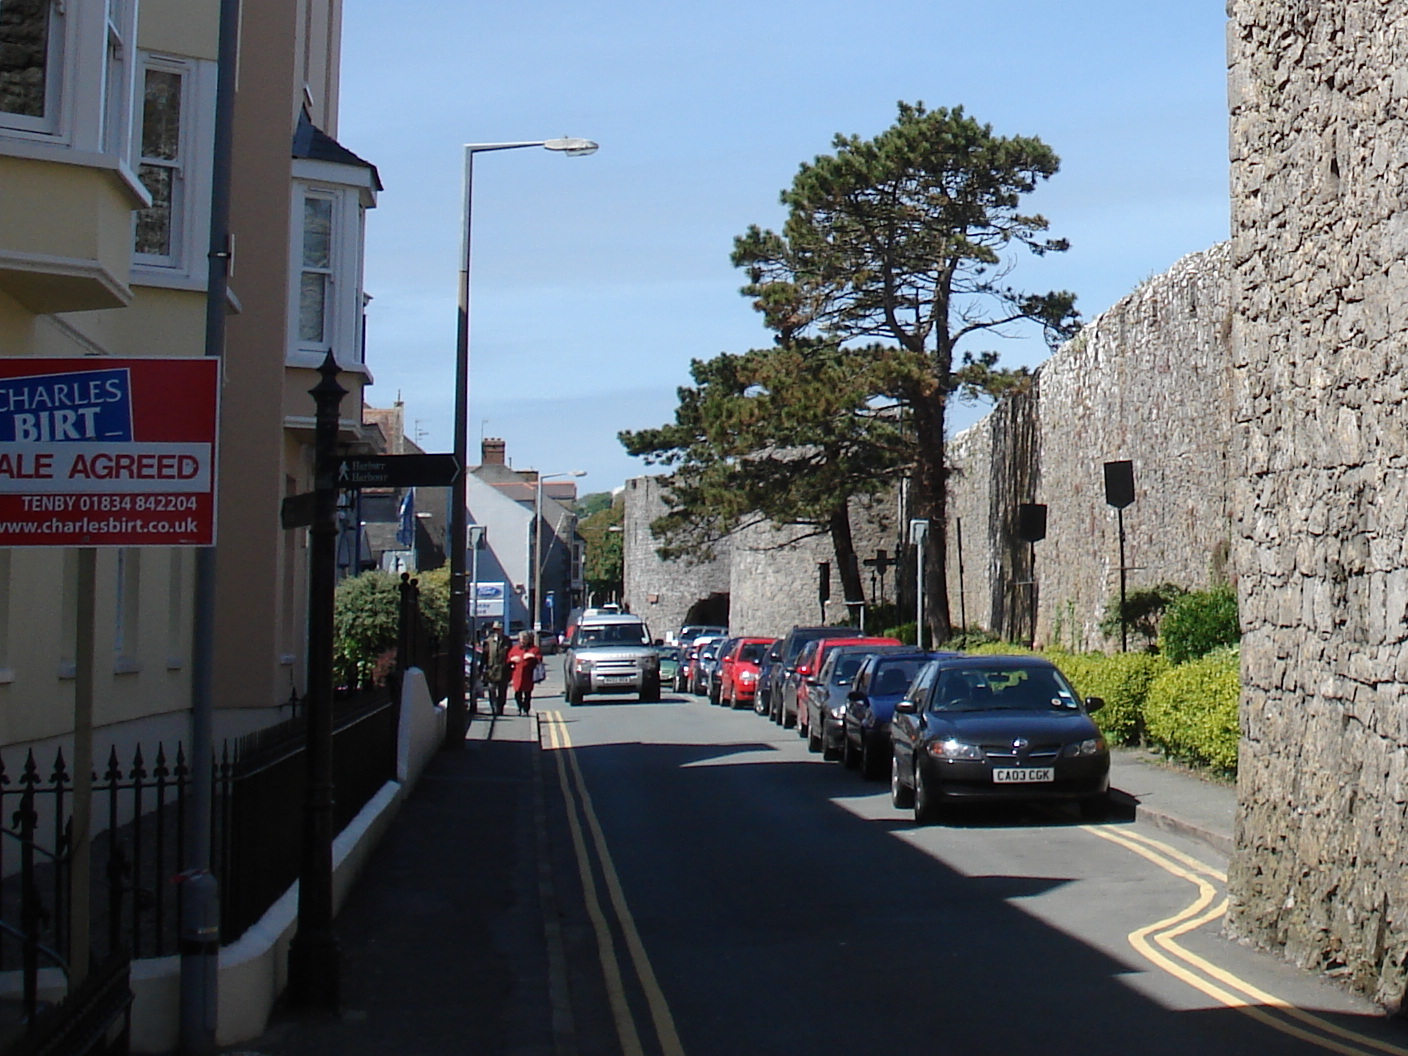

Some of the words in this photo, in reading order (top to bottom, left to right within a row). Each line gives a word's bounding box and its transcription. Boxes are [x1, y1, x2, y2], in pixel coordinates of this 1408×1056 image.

[14, 406, 101, 442] BIRT
[0, 453, 54, 479] ALE
[68, 453, 199, 480] AGREED
[22, 496, 76, 512] TENBY
[80, 496, 131, 511] 01834
[135, 496, 197, 511] 842204
[997, 770, 1026, 781] CA03
[1029, 770, 1050, 780] CGK
